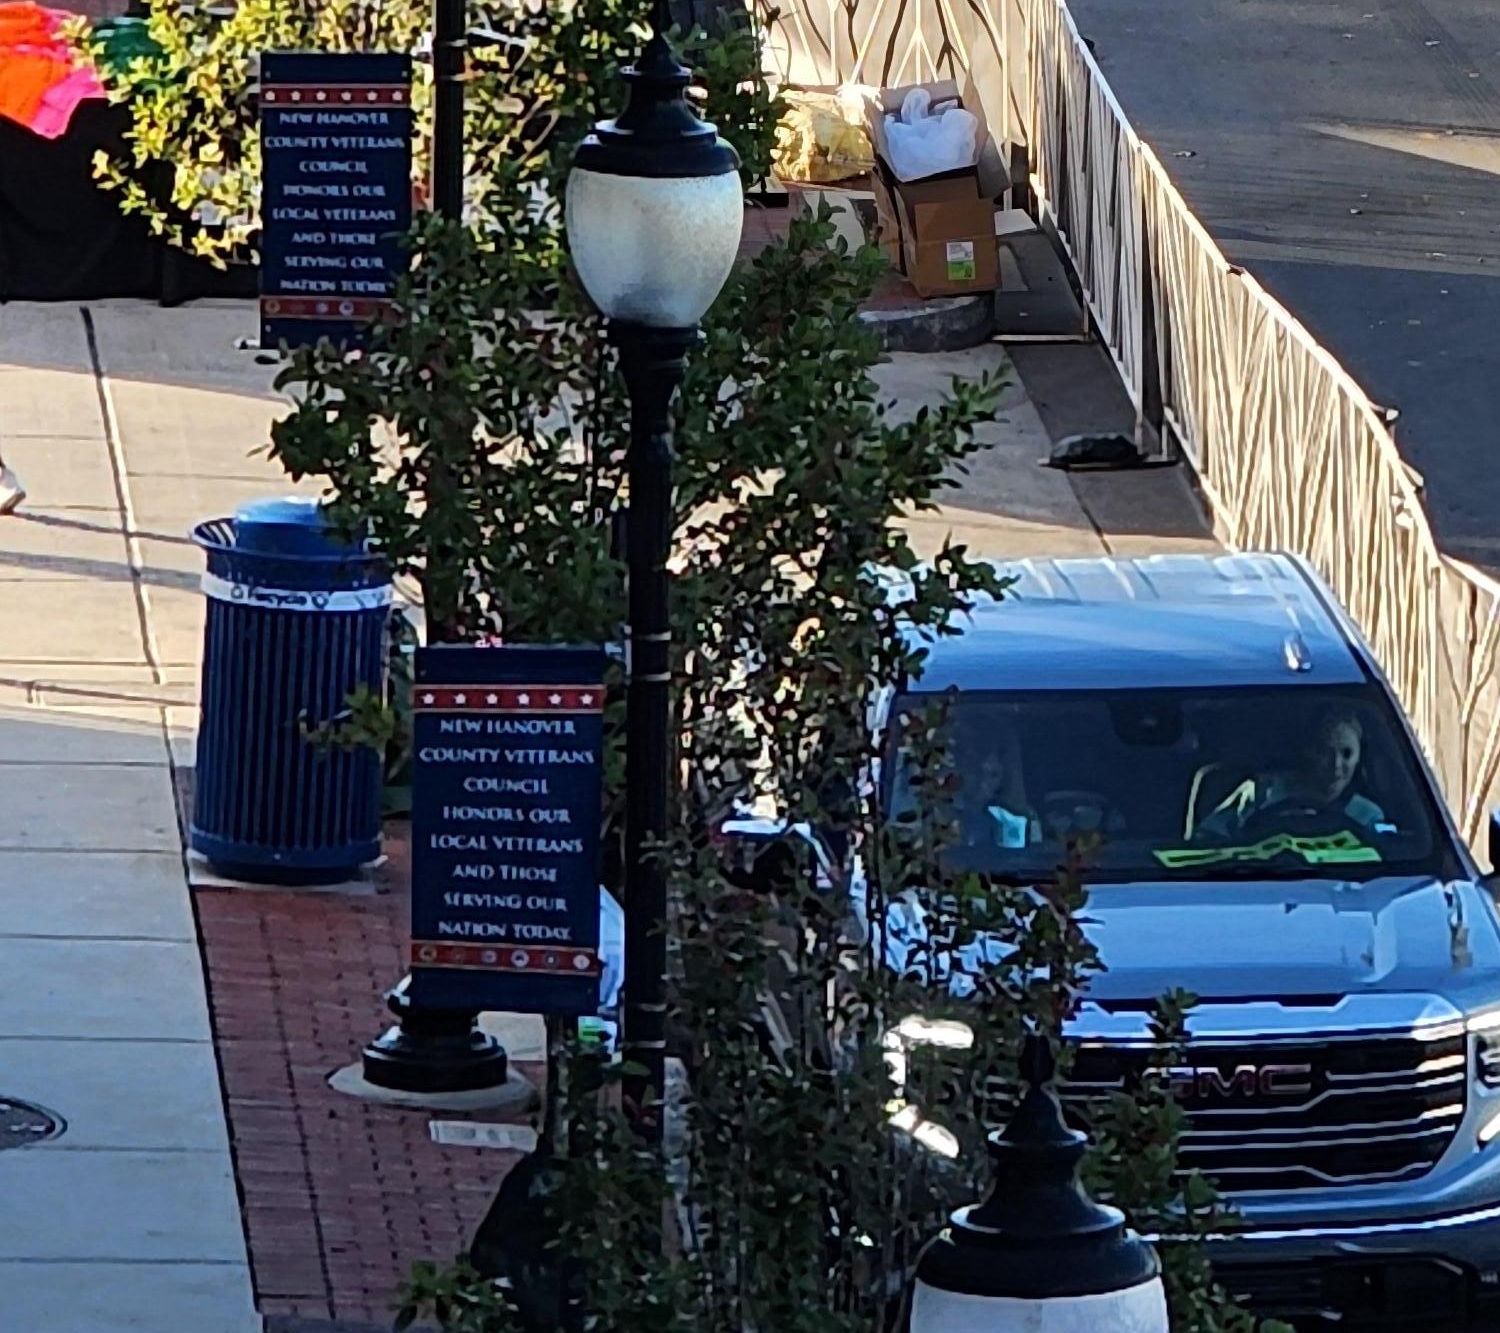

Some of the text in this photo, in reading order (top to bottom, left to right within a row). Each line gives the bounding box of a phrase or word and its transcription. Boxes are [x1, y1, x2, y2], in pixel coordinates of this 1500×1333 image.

[440, 718, 576, 735] NEW HANOVER
[419, 747, 595, 764] COUNTY VETERANS
[463, 777, 549, 794] COUNCIL
[442, 805, 571, 823] HONORS OUR
[430, 834, 584, 852] LOCAL VETERANS
[452, 864, 558, 882] AND THOSE
[443, 891, 568, 912] SERVING OUR
[438, 921, 507, 937] NATION
